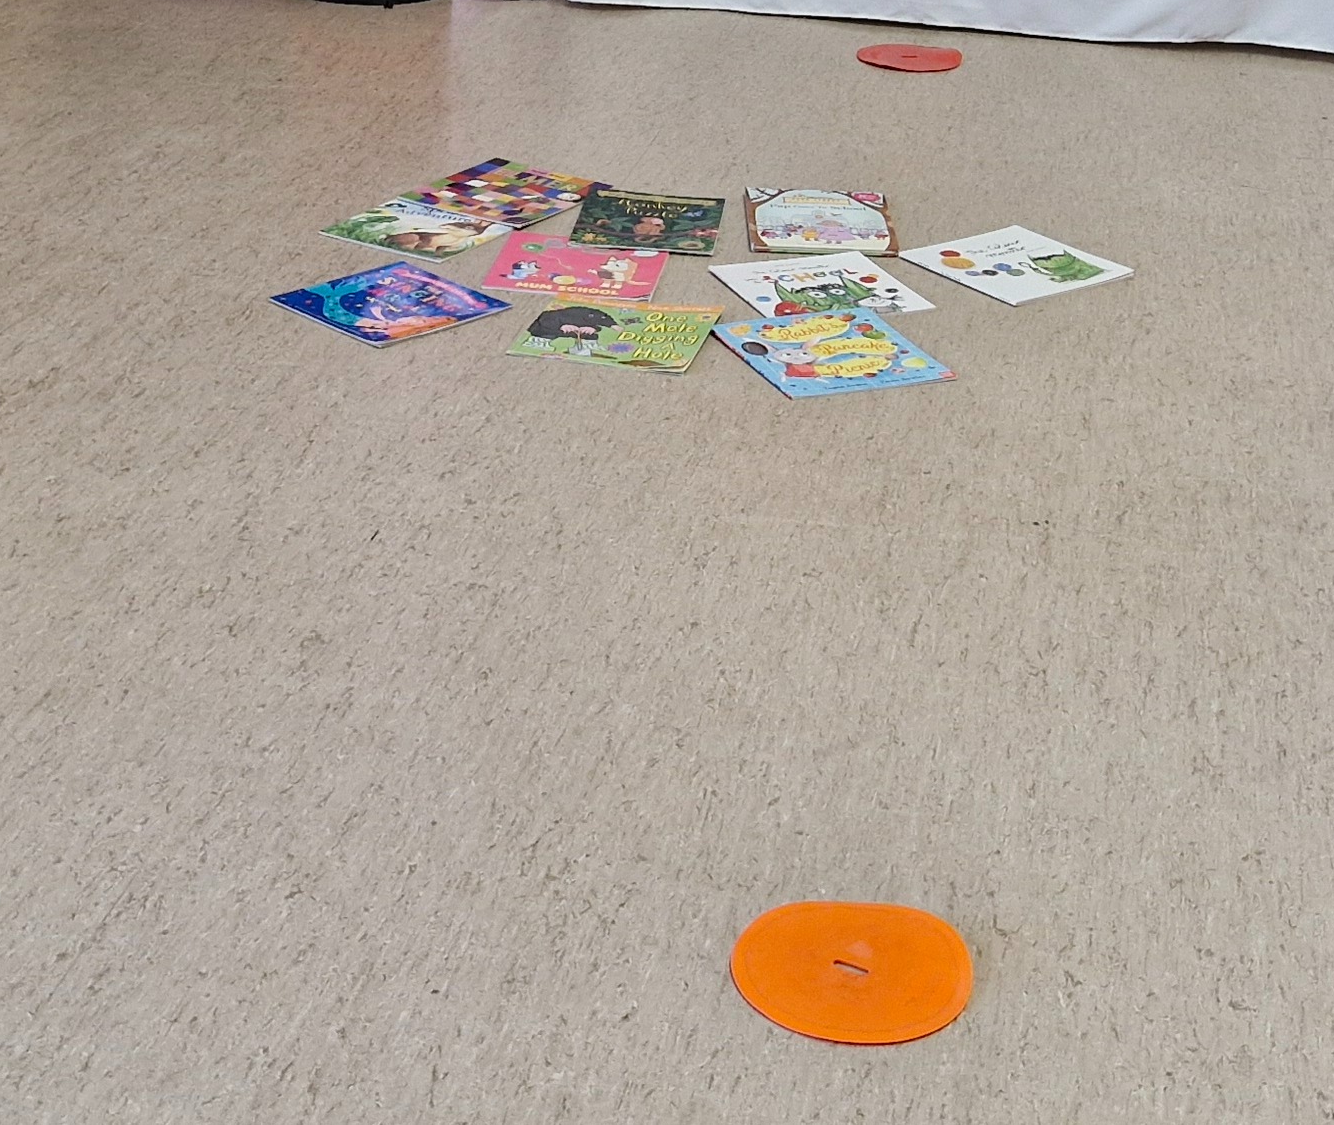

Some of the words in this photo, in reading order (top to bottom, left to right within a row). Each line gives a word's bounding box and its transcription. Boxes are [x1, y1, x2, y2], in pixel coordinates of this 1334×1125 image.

[515, 281, 553, 292] MUM
[557, 285, 620, 296] SCHOOL
[646, 312, 688, 323] One
[643, 323, 697, 334] Mole
[633, 348, 683, 361] Hole
